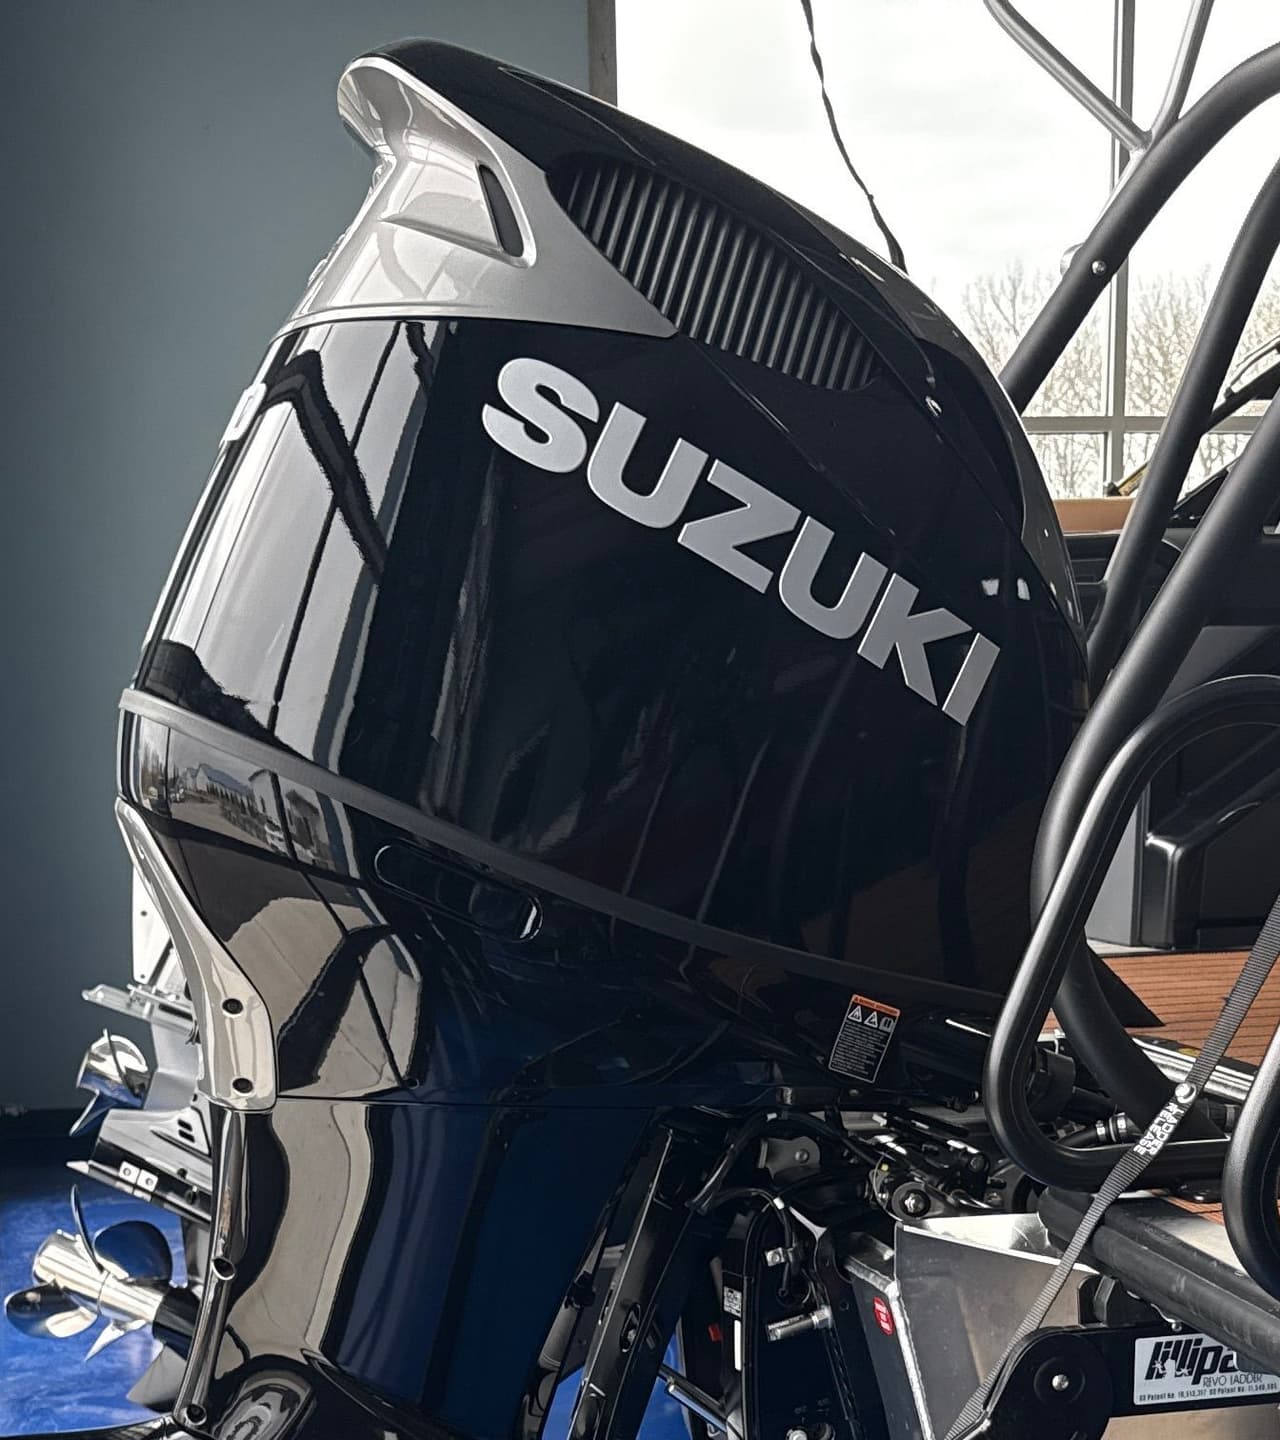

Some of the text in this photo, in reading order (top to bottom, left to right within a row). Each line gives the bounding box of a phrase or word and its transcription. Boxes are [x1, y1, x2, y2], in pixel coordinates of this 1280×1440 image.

[481, 356, 1001, 726] SUZUKI
[1133, 1102, 1178, 1156] RELEASE
[1148, 1108, 1185, 1155] LADDER
